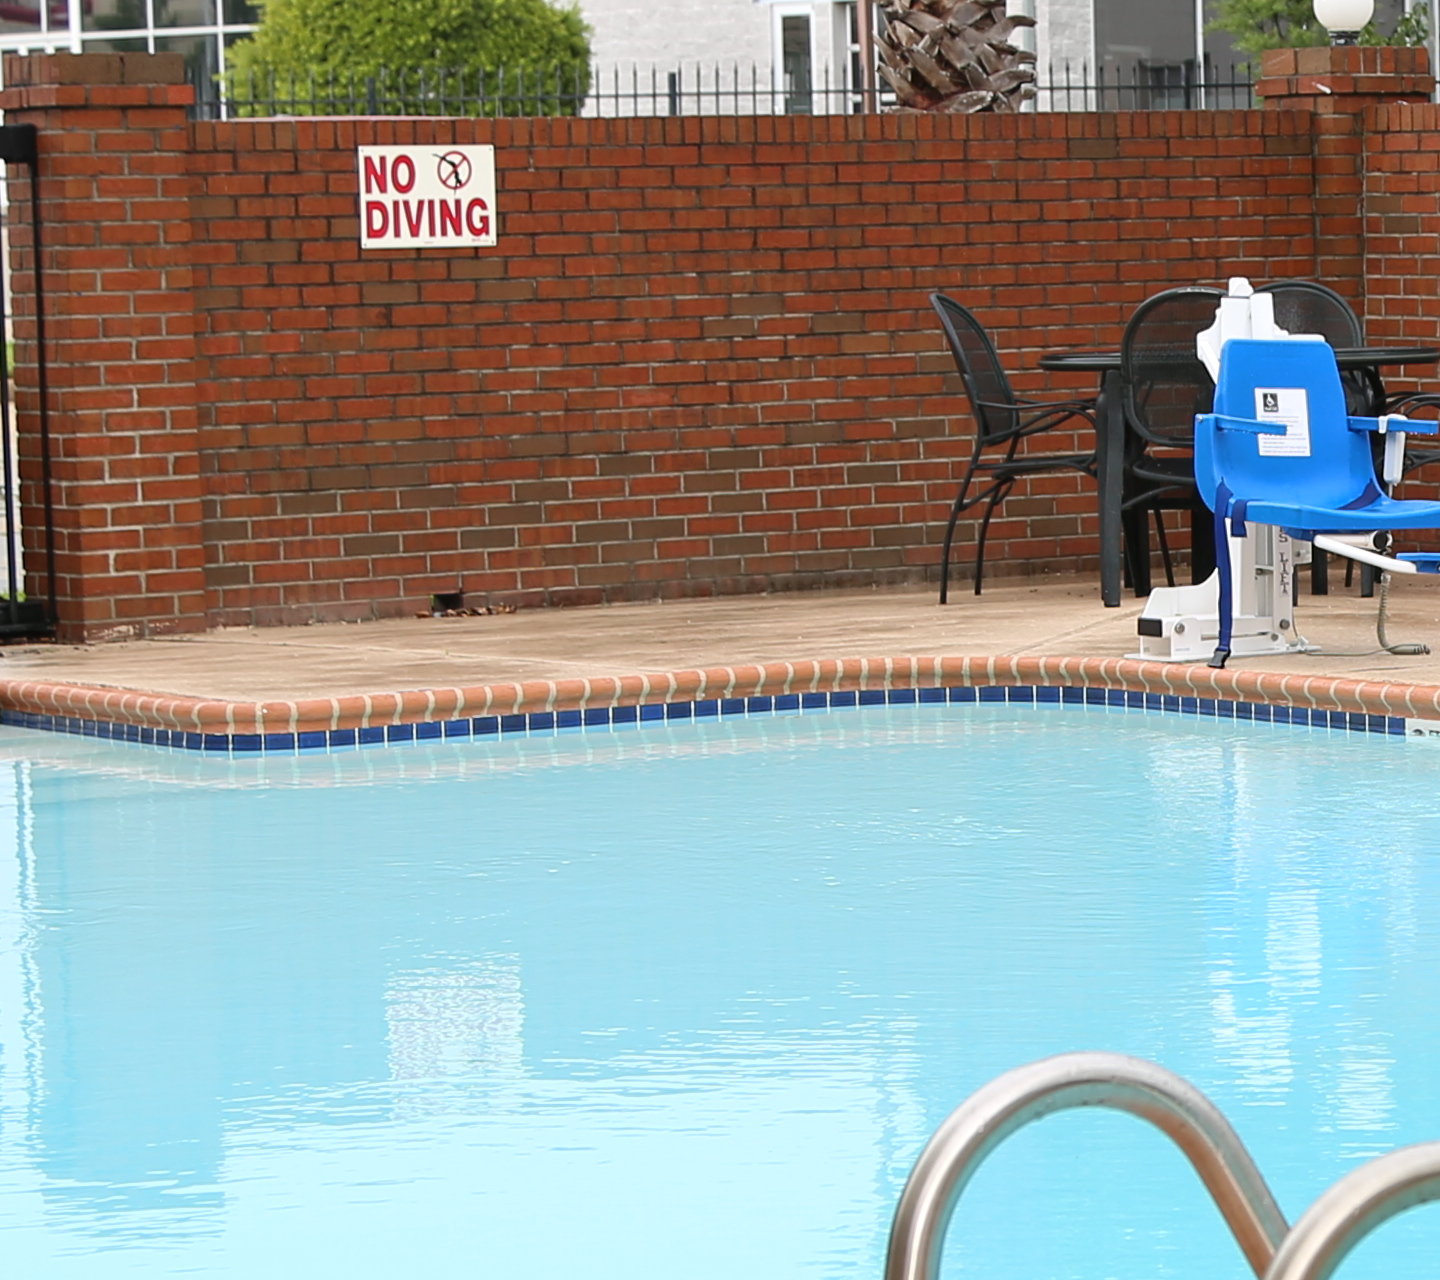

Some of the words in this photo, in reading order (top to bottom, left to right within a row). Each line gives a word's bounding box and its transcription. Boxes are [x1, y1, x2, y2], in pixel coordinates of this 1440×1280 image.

[364, 154, 416, 194] NO
[366, 197, 490, 239] DIVING
[1279, 551, 1290, 594] LIFT
